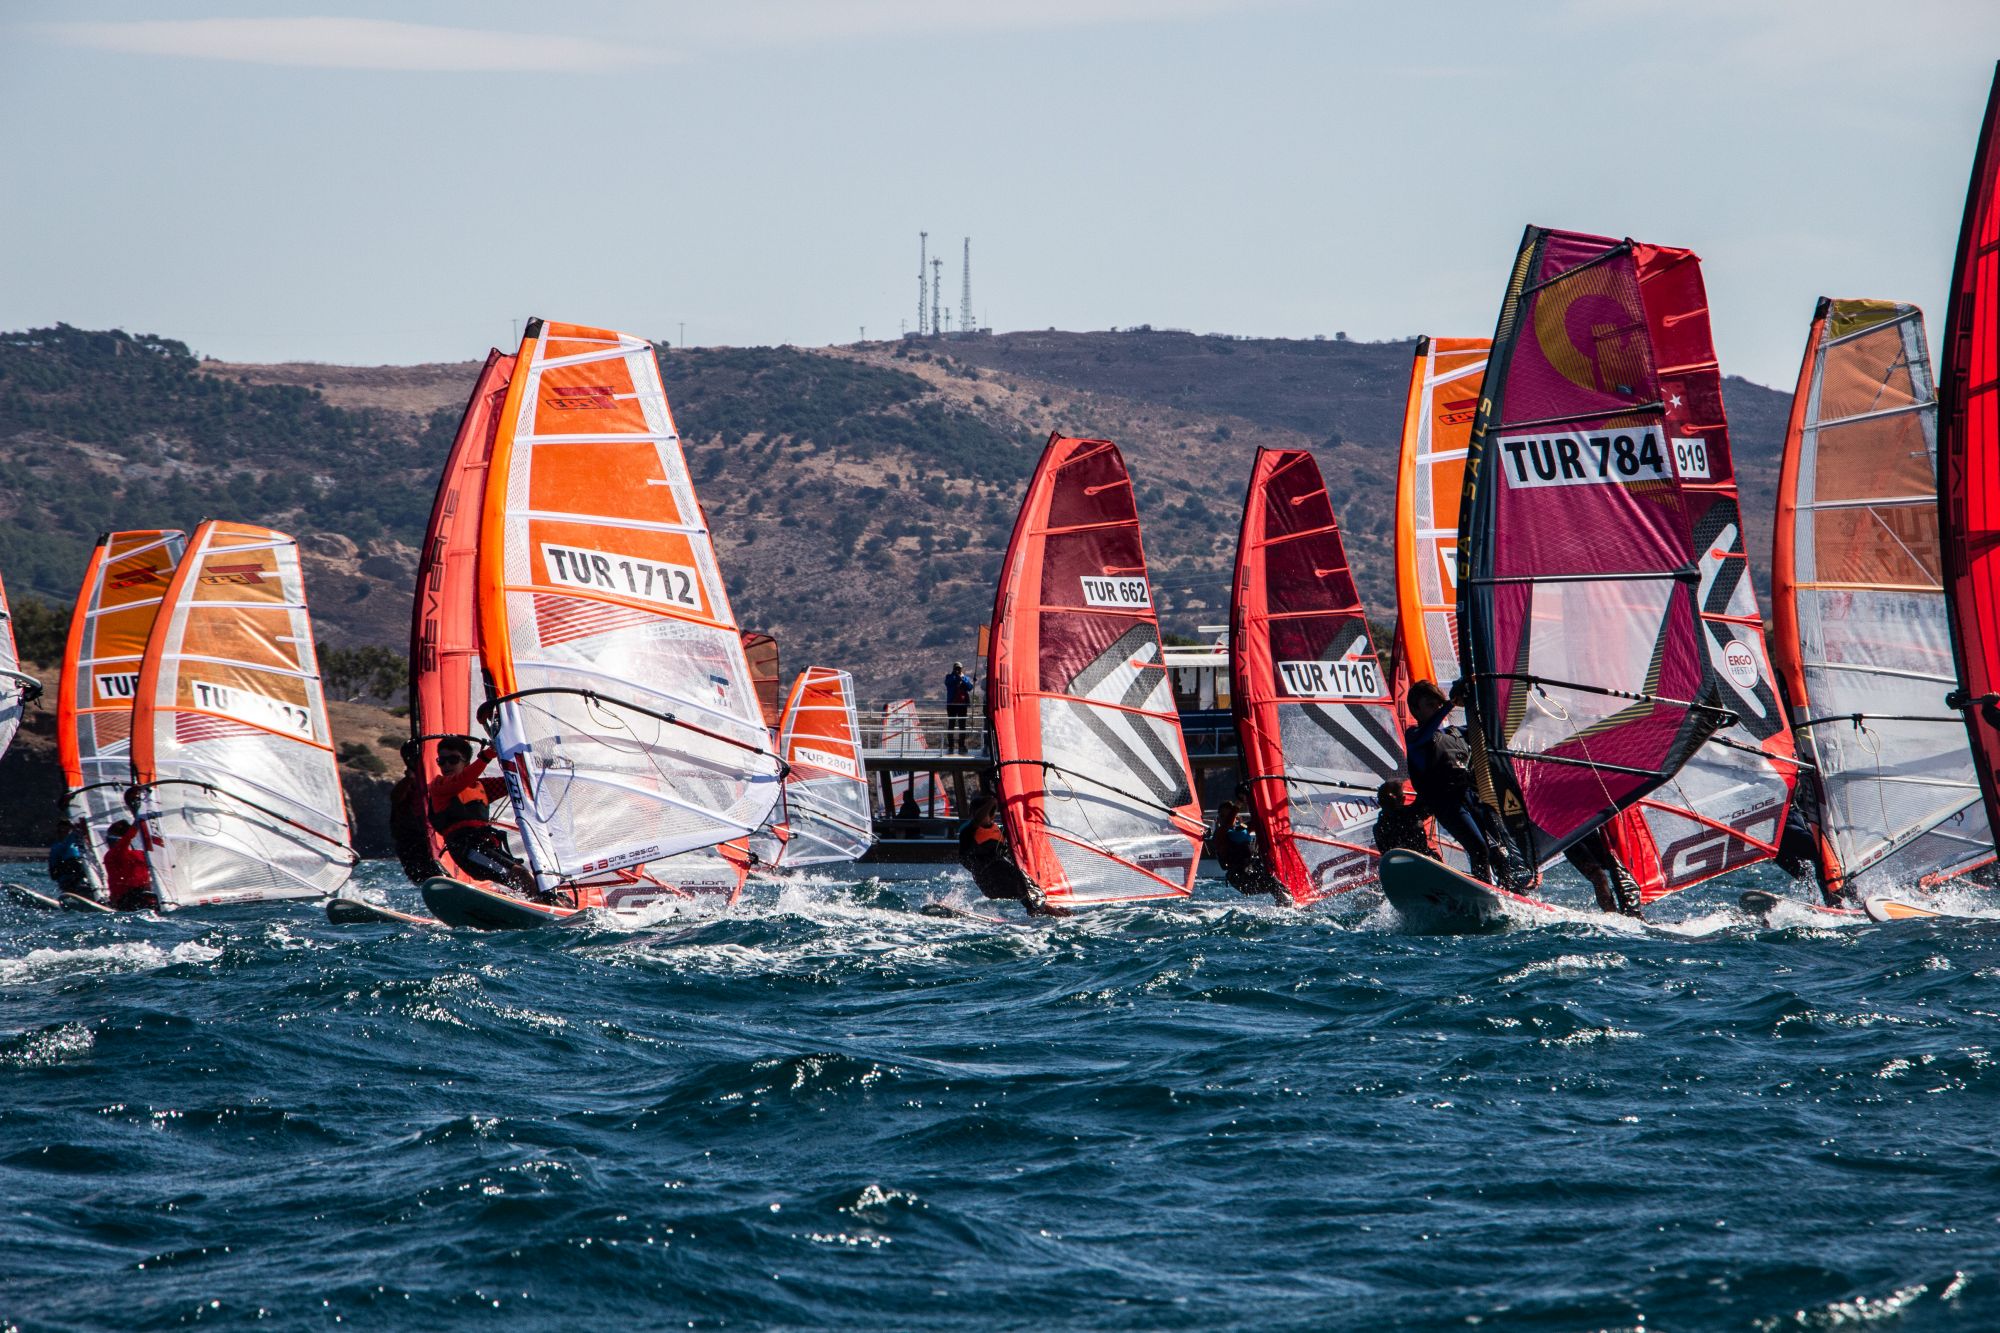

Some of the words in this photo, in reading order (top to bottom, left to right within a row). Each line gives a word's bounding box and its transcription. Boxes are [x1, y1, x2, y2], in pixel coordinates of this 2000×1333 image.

[1504, 438, 1588, 482] TUR
[1589, 433, 1665, 478] 784
[1677, 444, 1706, 472] 919
[547, 548, 616, 590] TUR
[619, 560, 695, 605] 1712
[1084, 581, 1119, 602] TUR
[1119, 581, 1148, 603] 662
[1728, 655, 1752, 666] ERGO
[1730, 666, 1755, 676] HESTIA
[1282, 663, 1328, 692] TUR
[1330, 663, 1375, 694] 1716
[197, 684, 238, 711] TU
[798, 749, 824, 764] TUR
[1732, 798, 1776, 819] GLIDE
[1138, 851, 1183, 860] GLIDE
